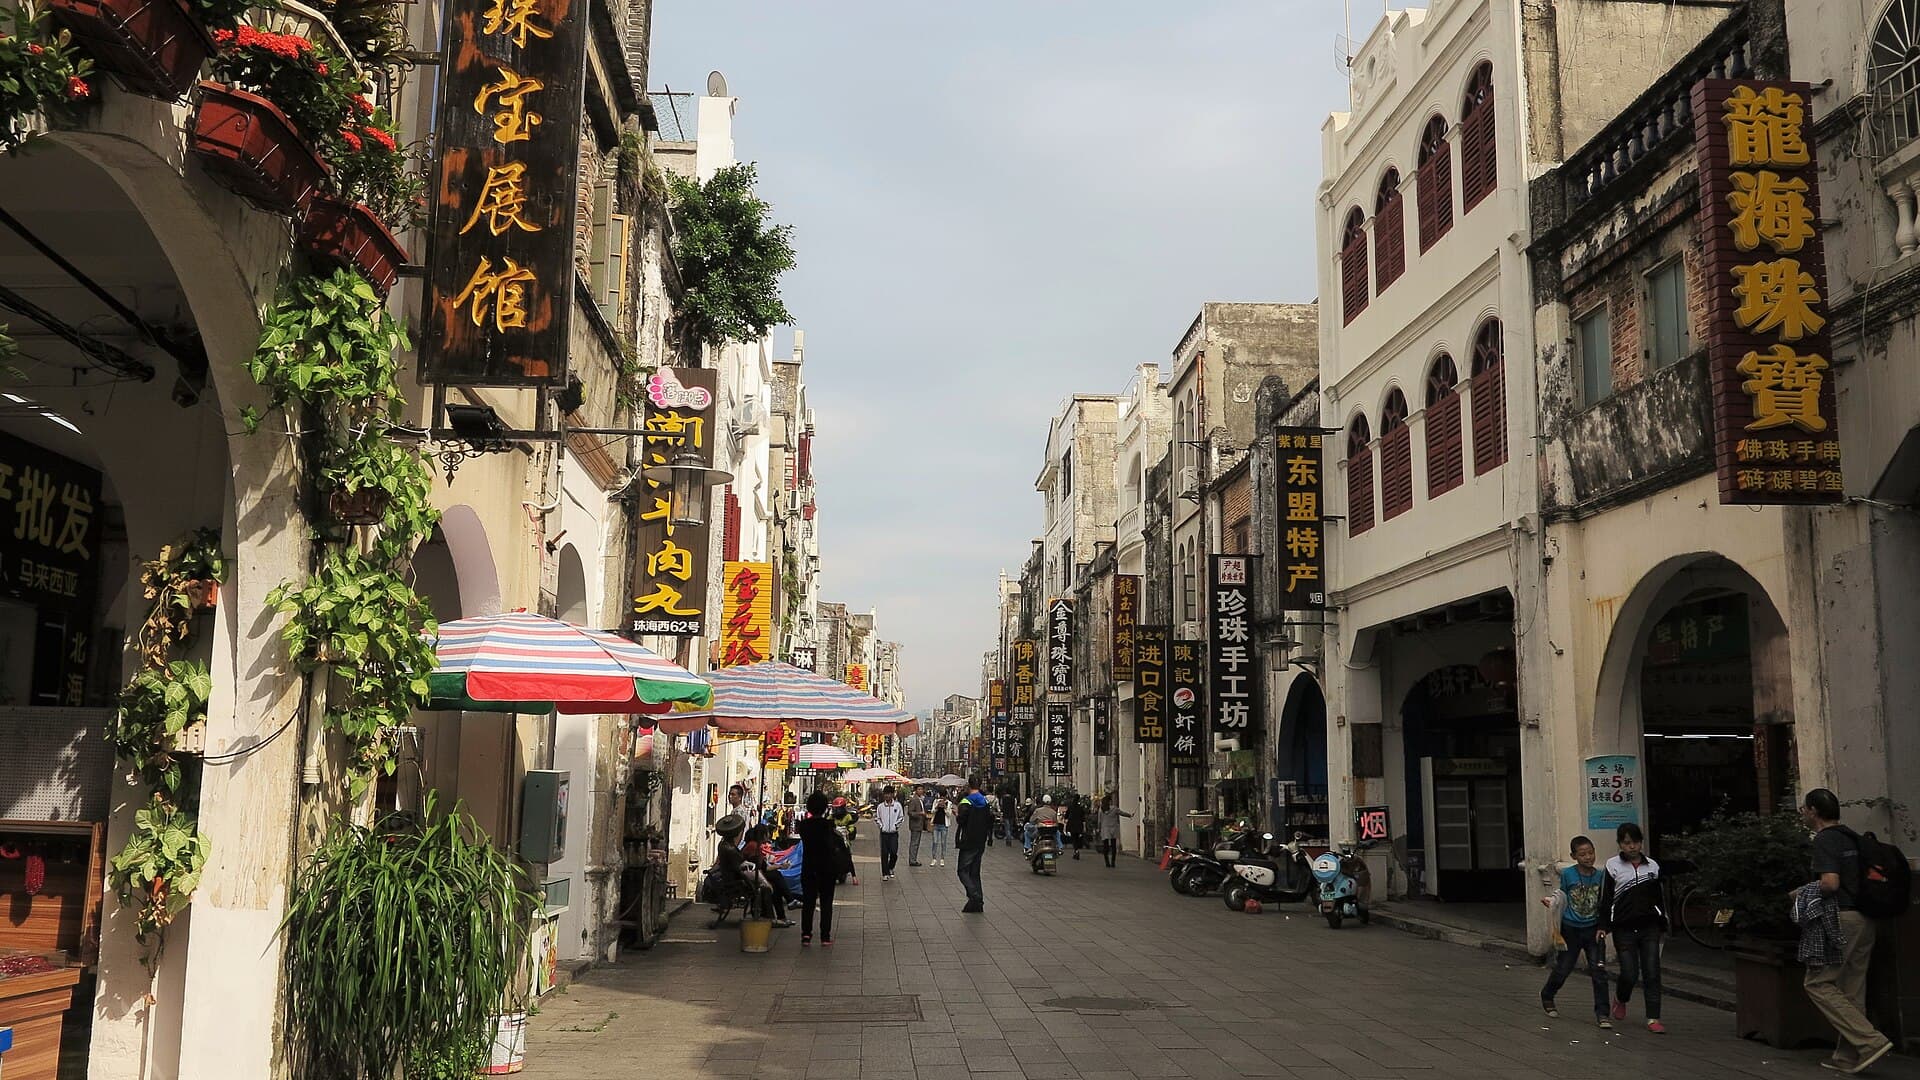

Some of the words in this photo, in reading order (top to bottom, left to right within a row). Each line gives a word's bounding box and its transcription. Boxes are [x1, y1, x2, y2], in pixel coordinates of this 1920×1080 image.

[453, 0, 554, 334] 珠宝展馆
[1722, 85, 1828, 433] 龍海珠寶
[1277, 434, 1322, 449] 紫微星
[1742, 439, 1840, 460] 佛珠手串
[1286, 455, 1319, 594] 东盟特产
[633, 620, 700, 633] 珠海西62号
[1050, 599, 1073, 686] 金尊珠寶
[1173, 645, 1195, 684] 陳記
[1217, 589, 1250, 729] 珍珠手工坊
[1137, 645, 1164, 738] 进口食品
[1590, 775, 1633, 789] 夏装5折
[1361, 811, 1388, 840] 烟
